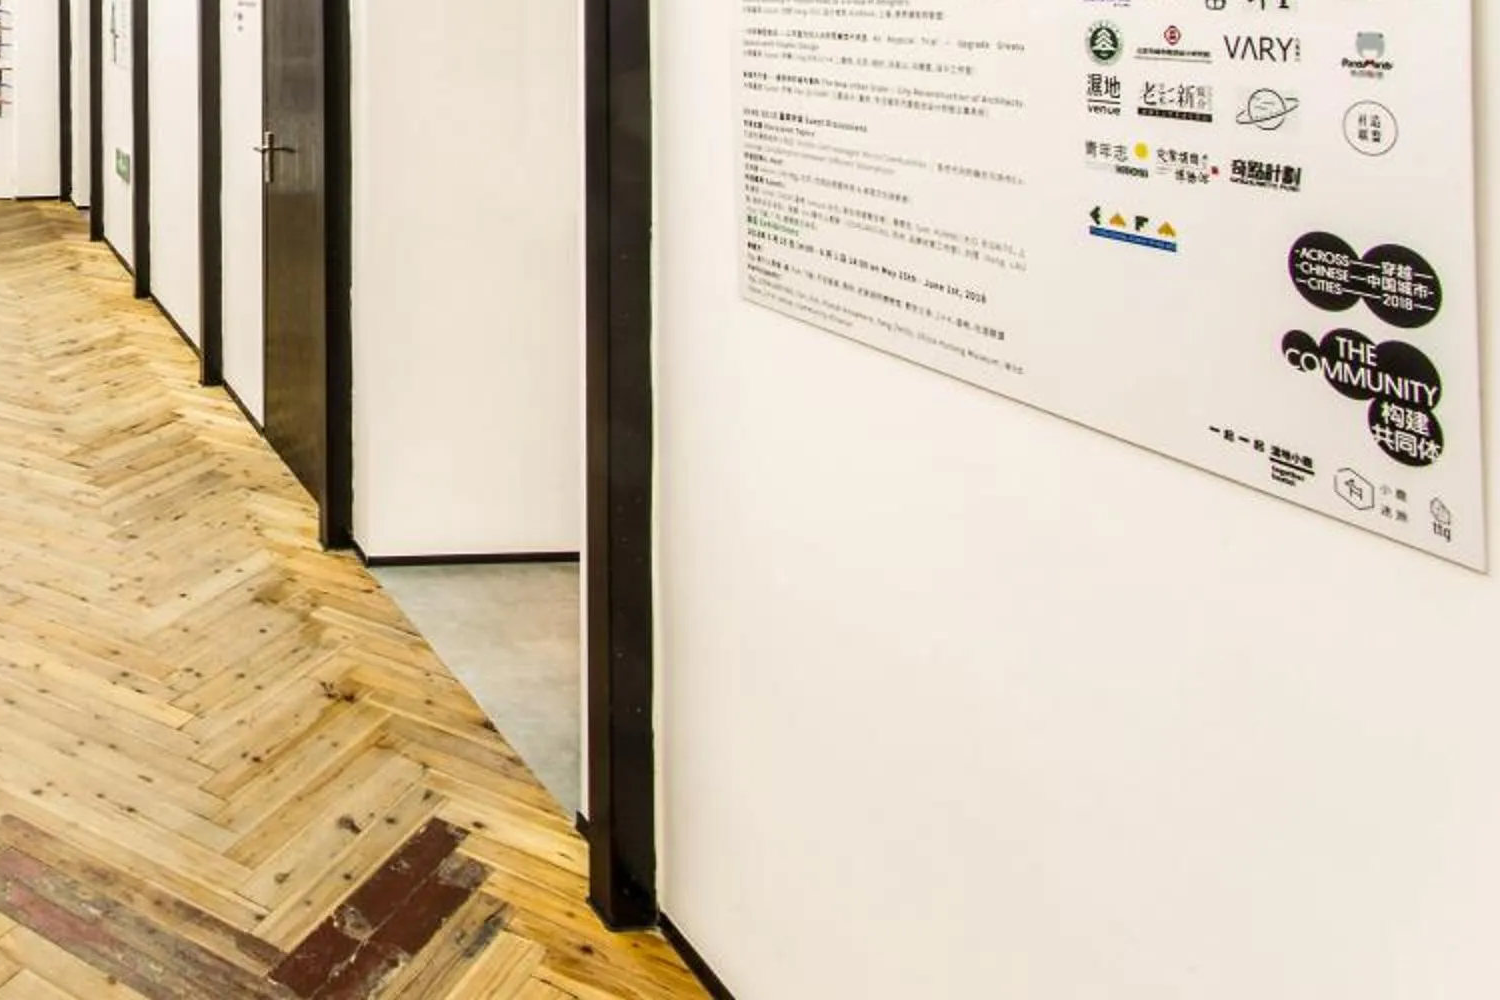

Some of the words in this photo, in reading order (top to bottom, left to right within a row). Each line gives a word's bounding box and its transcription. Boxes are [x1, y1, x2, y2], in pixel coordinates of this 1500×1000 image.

[1223, 34, 1295, 63] VARY
[1087, 104, 1122, 117] venue
[1299, 247, 1350, 267] ACROSS
[1299, 261, 1349, 281] CHINESE
[1380, 261, 1413, 280] 穿越
[1307, 278, 1343, 295] CITIES
[1366, 274, 1429, 299] 中国城市
[1382, 294, 1414, 311] 2018
[1335, 335, 1378, 367] THE
[1285, 347, 1439, 407] COMMUNITY
[1380, 402, 1432, 437] 构建
[1371, 423, 1442, 463] 共同体
